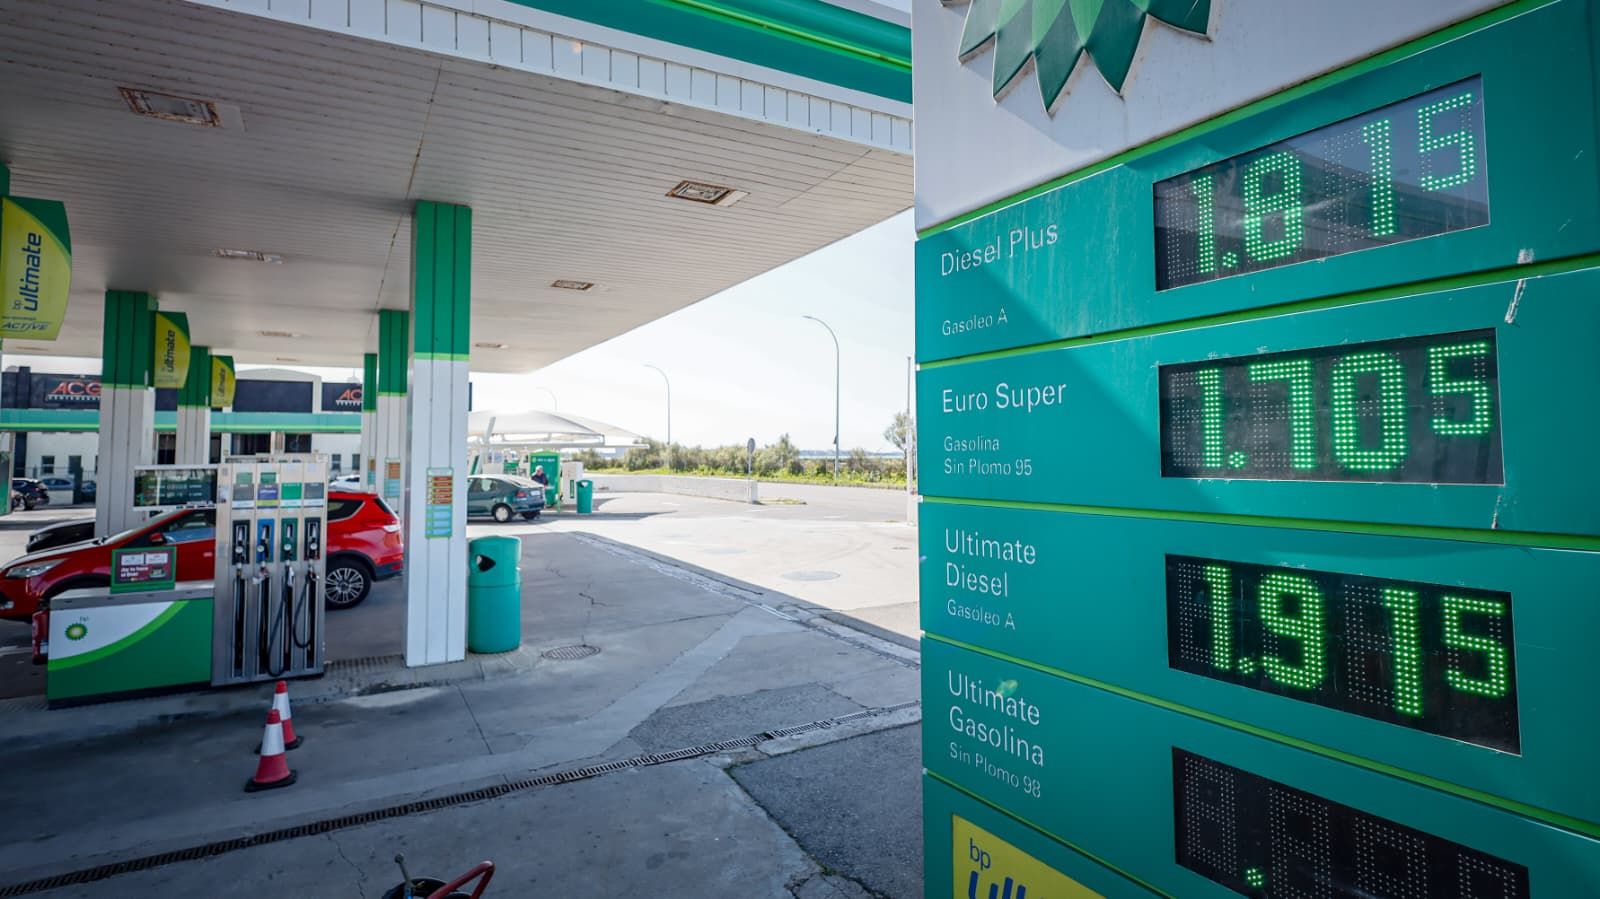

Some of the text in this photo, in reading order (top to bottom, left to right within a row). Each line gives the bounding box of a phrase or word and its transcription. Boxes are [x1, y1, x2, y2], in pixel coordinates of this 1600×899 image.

[1192, 93, 1476, 274] 1.815
[19, 231, 42, 312] ultimate
[941, 224, 1058, 276] Diesel Plus
[997, 307, 1008, 325] A
[942, 382, 1067, 413] Euro Super
[1195, 342, 1490, 470] 1.705
[943, 434, 1000, 452] Gasolina
[943, 457, 1033, 476] Sin Plomo 95
[945, 527, 1037, 565] Ultimate
[946, 561, 1008, 597] Diesel
[1004, 611, 1016, 631] A
[1204, 564, 1507, 716] 1.915
[948, 669, 1041, 726] Ultimate
[949, 705, 1045, 768] Gasolina
[949, 741, 1042, 799] Sin Plomo 98
[969, 837, 992, 871] bp
